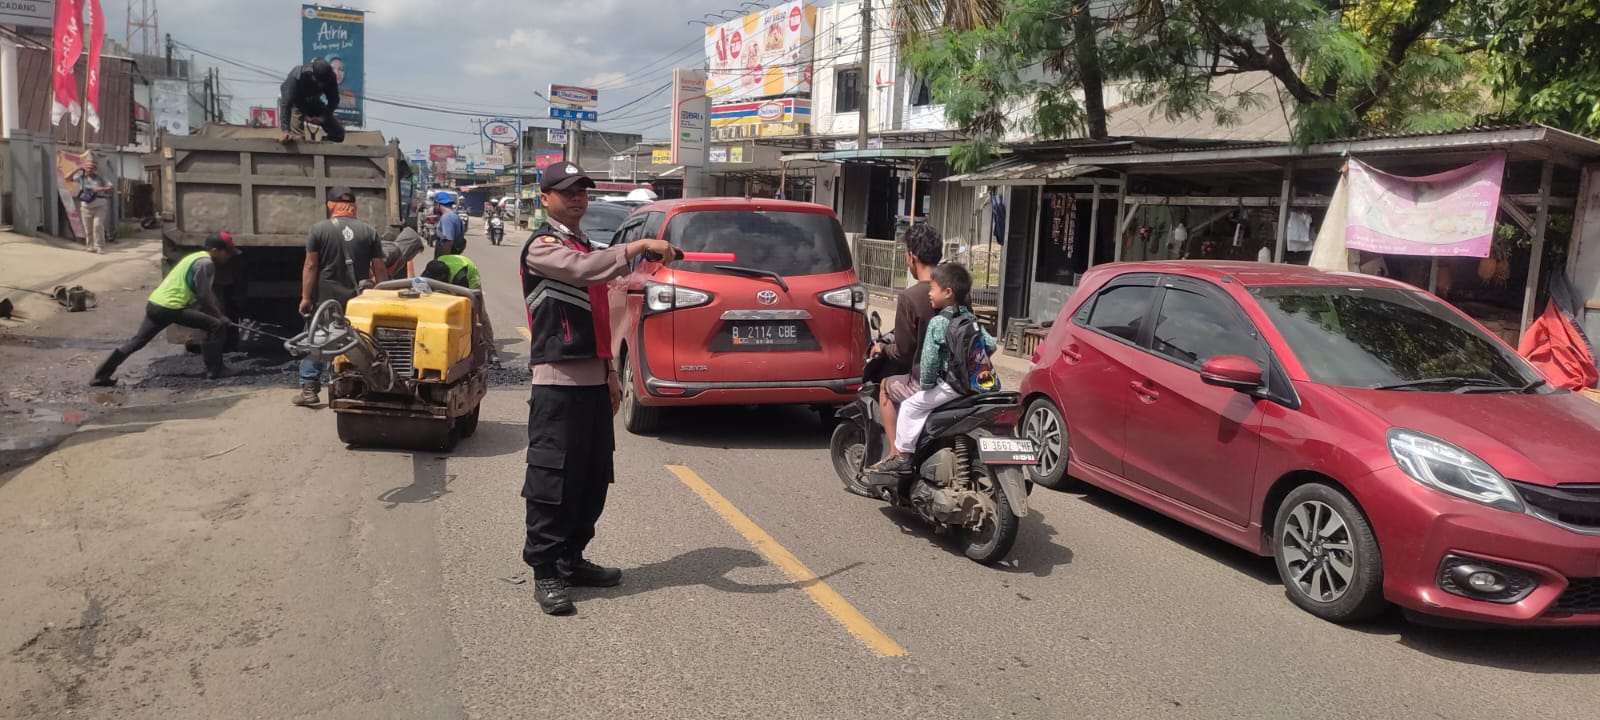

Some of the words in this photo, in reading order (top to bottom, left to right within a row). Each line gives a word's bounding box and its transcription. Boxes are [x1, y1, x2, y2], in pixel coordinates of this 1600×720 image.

[317, 22, 348, 41] Airin
[732, 326, 739, 339] B
[748, 325, 772, 338] 2114
[778, 325, 797, 338] CBE
